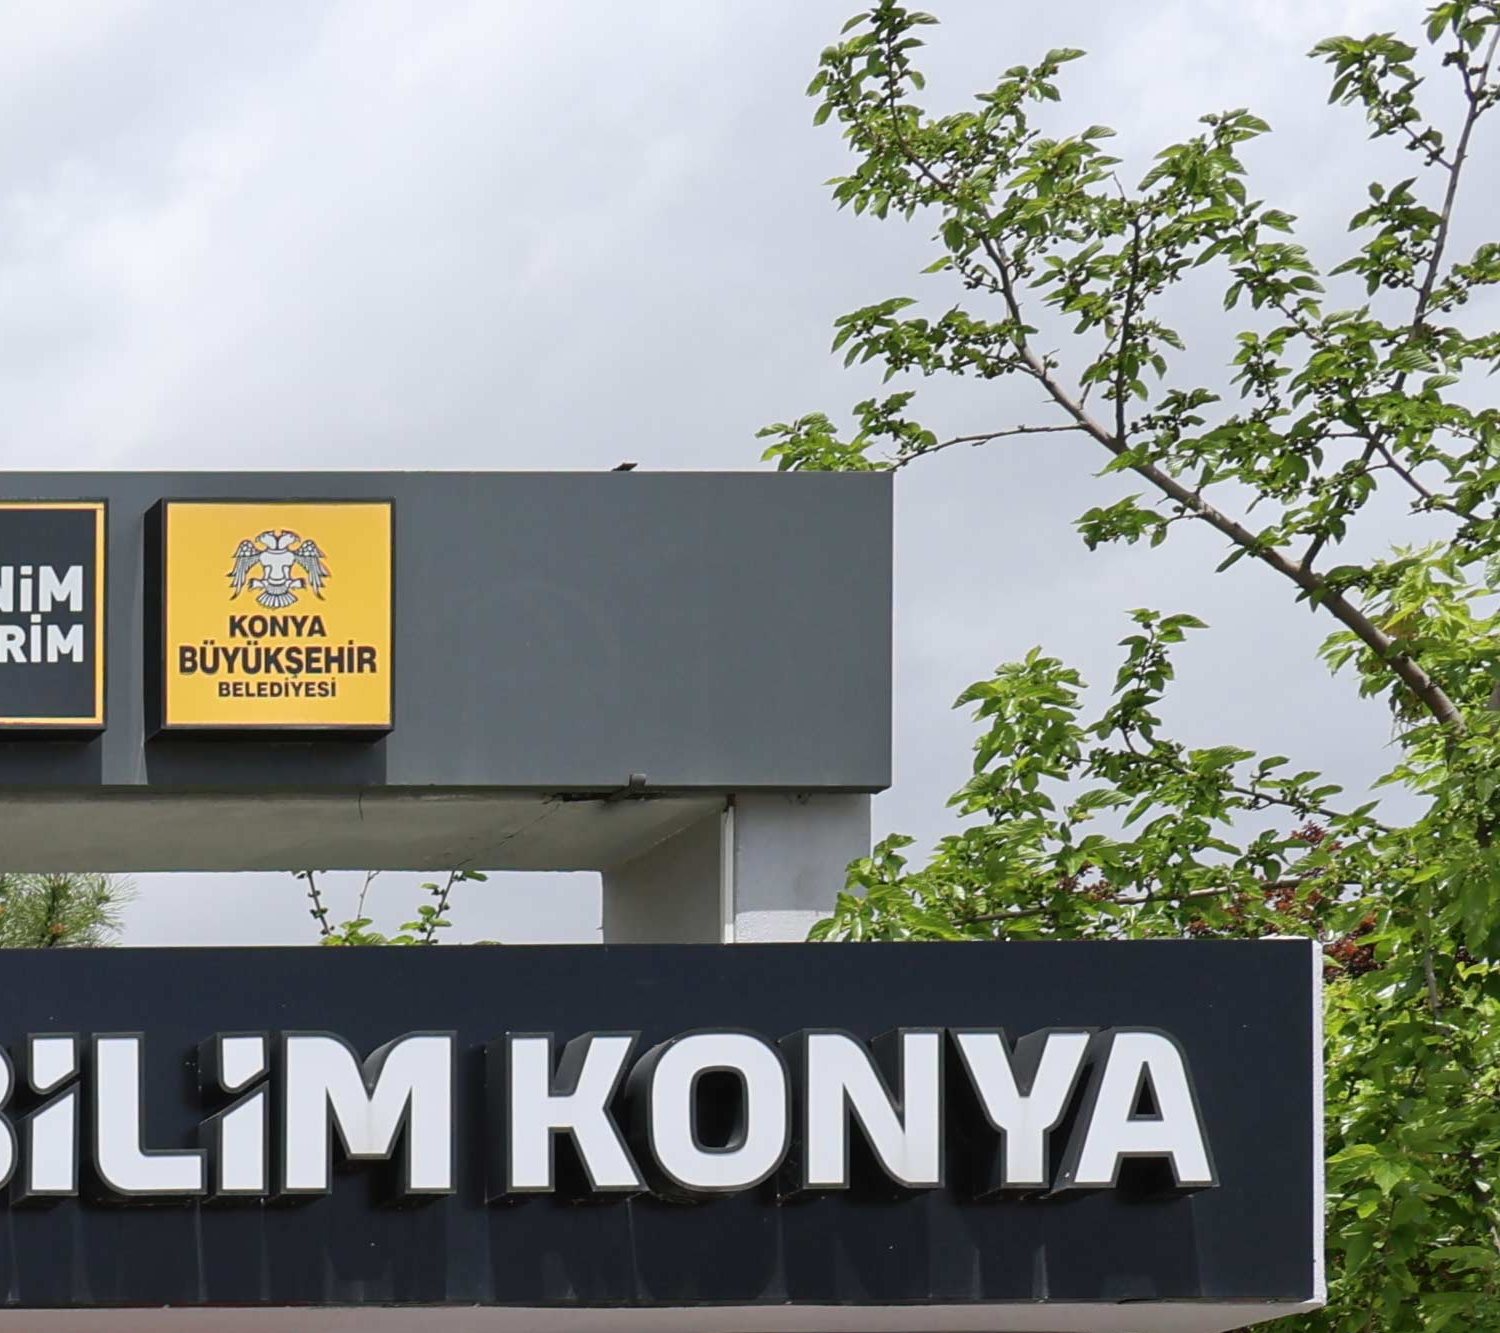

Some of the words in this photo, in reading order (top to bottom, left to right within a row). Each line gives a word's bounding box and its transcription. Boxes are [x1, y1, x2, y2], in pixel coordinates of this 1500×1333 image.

[229, 614, 328, 639] KONYA
[178, 639, 378, 680] BÜYÜKŞEHİR
[217, 678, 337, 698] BELEDİYESİ
[511, 1032, 1213, 1188] KONYA
